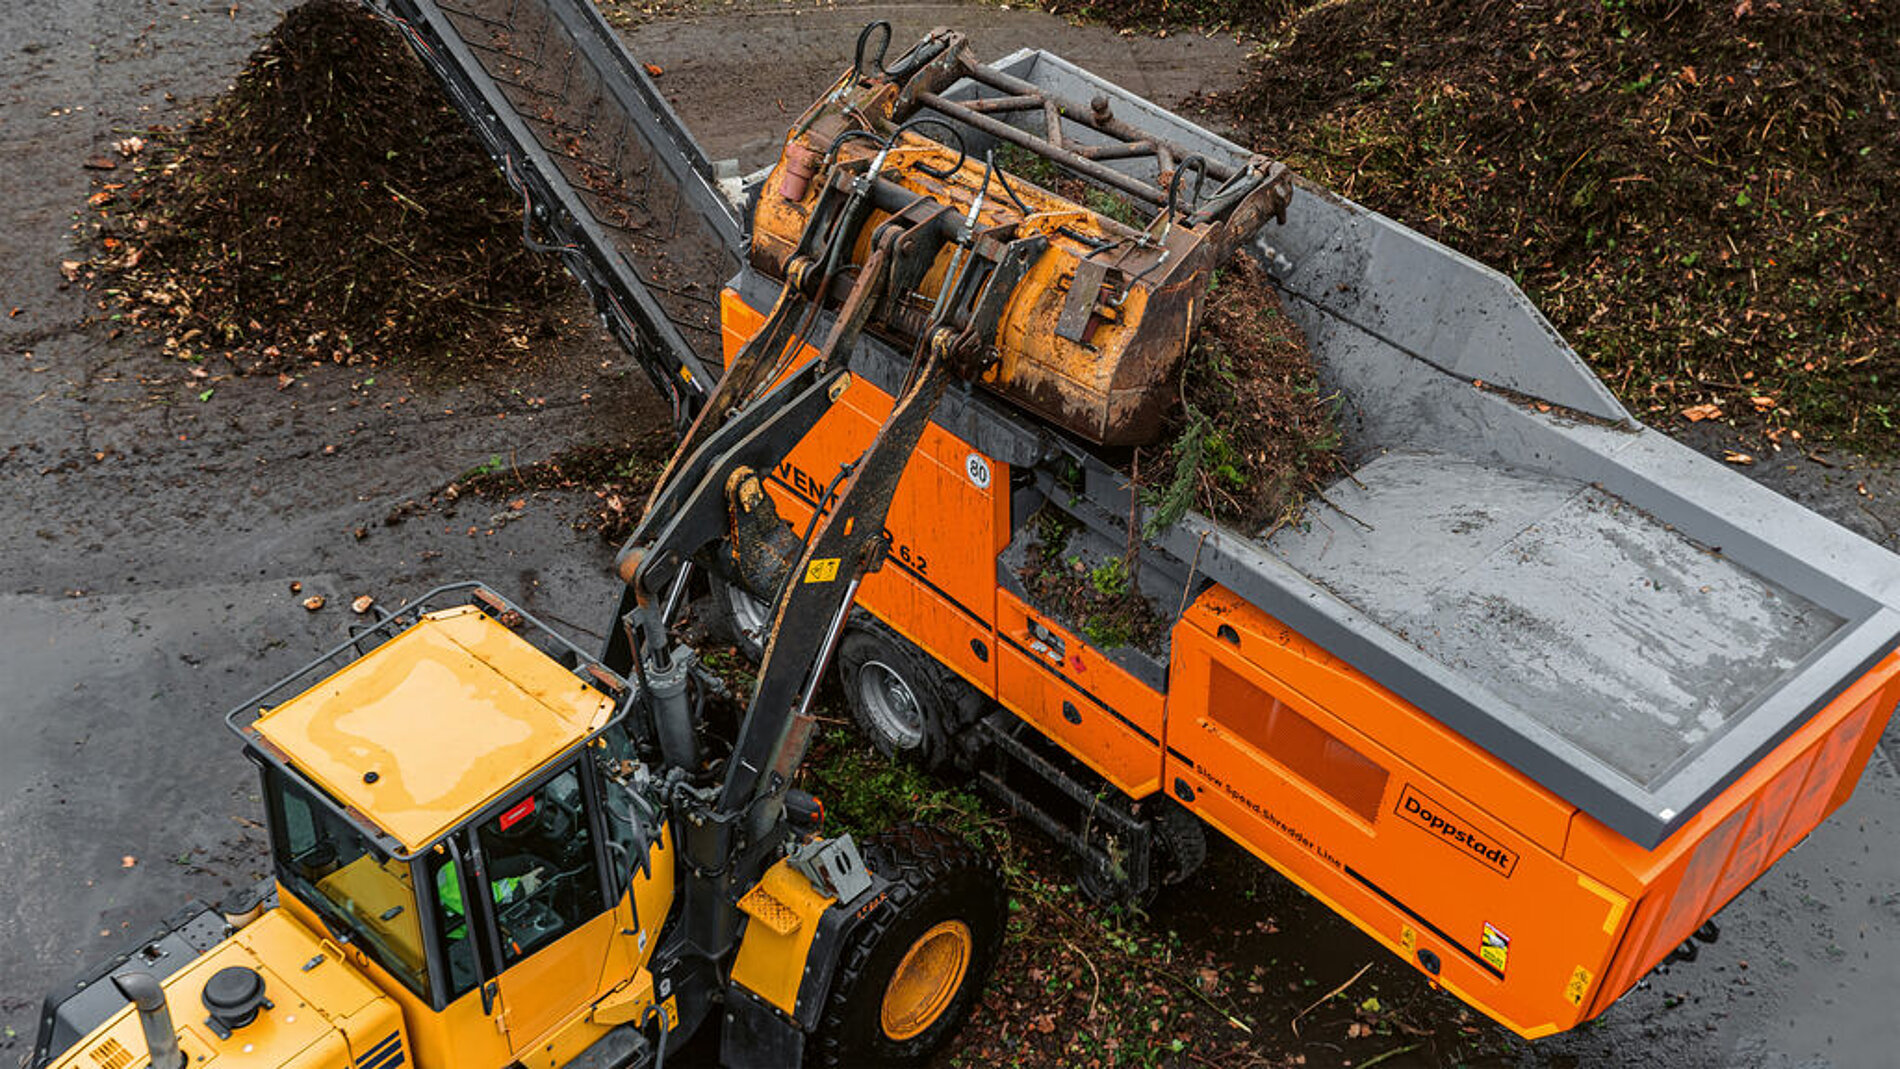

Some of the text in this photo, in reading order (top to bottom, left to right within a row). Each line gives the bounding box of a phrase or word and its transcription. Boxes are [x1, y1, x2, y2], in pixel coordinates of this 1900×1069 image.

[970, 459, 987, 483] 80
[900, 545, 927, 575] 6.2
[1196, 764, 1342, 868] Slow Speed Shredder Line
[1405, 796, 1509, 868] Doppstadt
